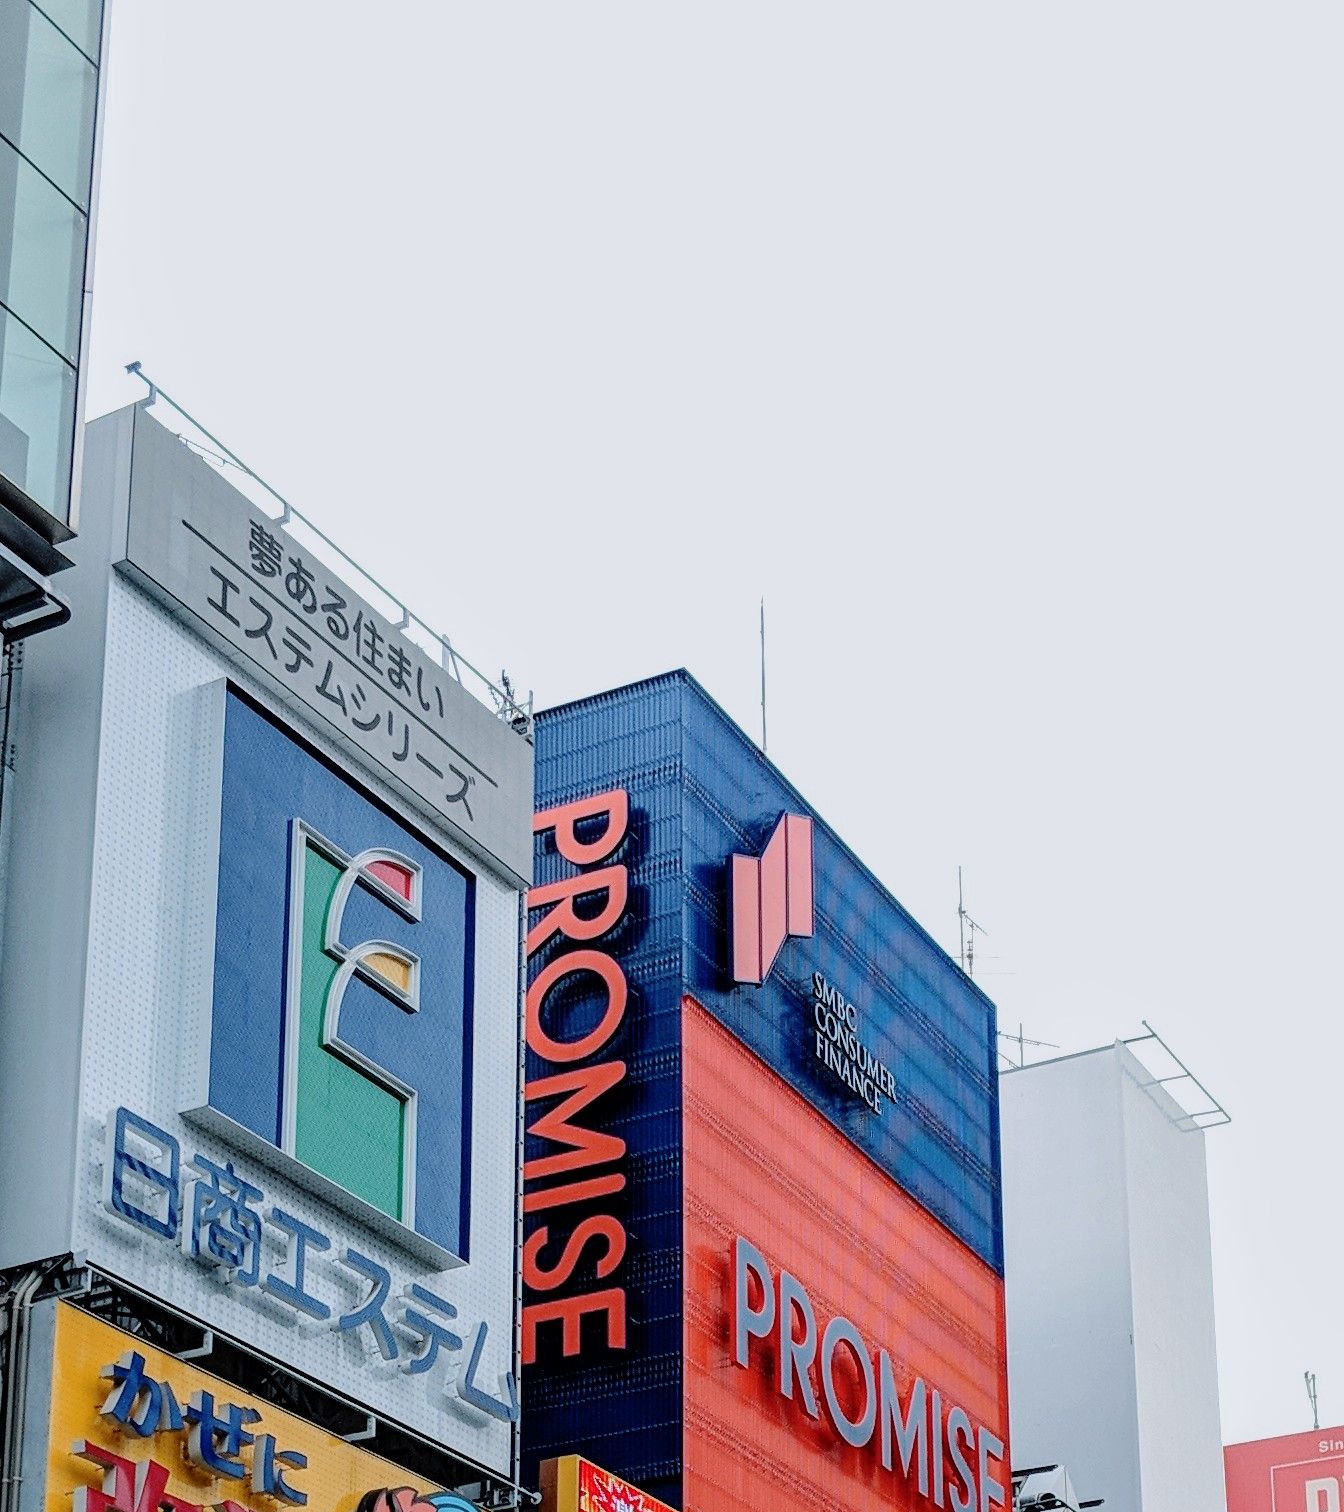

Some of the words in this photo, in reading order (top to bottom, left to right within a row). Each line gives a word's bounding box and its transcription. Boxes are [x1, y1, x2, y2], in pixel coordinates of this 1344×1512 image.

[206, 564, 478, 824] エステムシリーズ
[246, 516, 445, 720] 夢ある住まい
[522, 788, 628, 1365] PROMISE
[812, 971, 858, 1033] SMBC
[813, 1005, 898, 1105] CONSUMER
[814, 1030, 883, 1116] FINANCE
[104, 1104, 518, 1424] 日商エステム
[100, 1351, 308, 1506] かぜに
